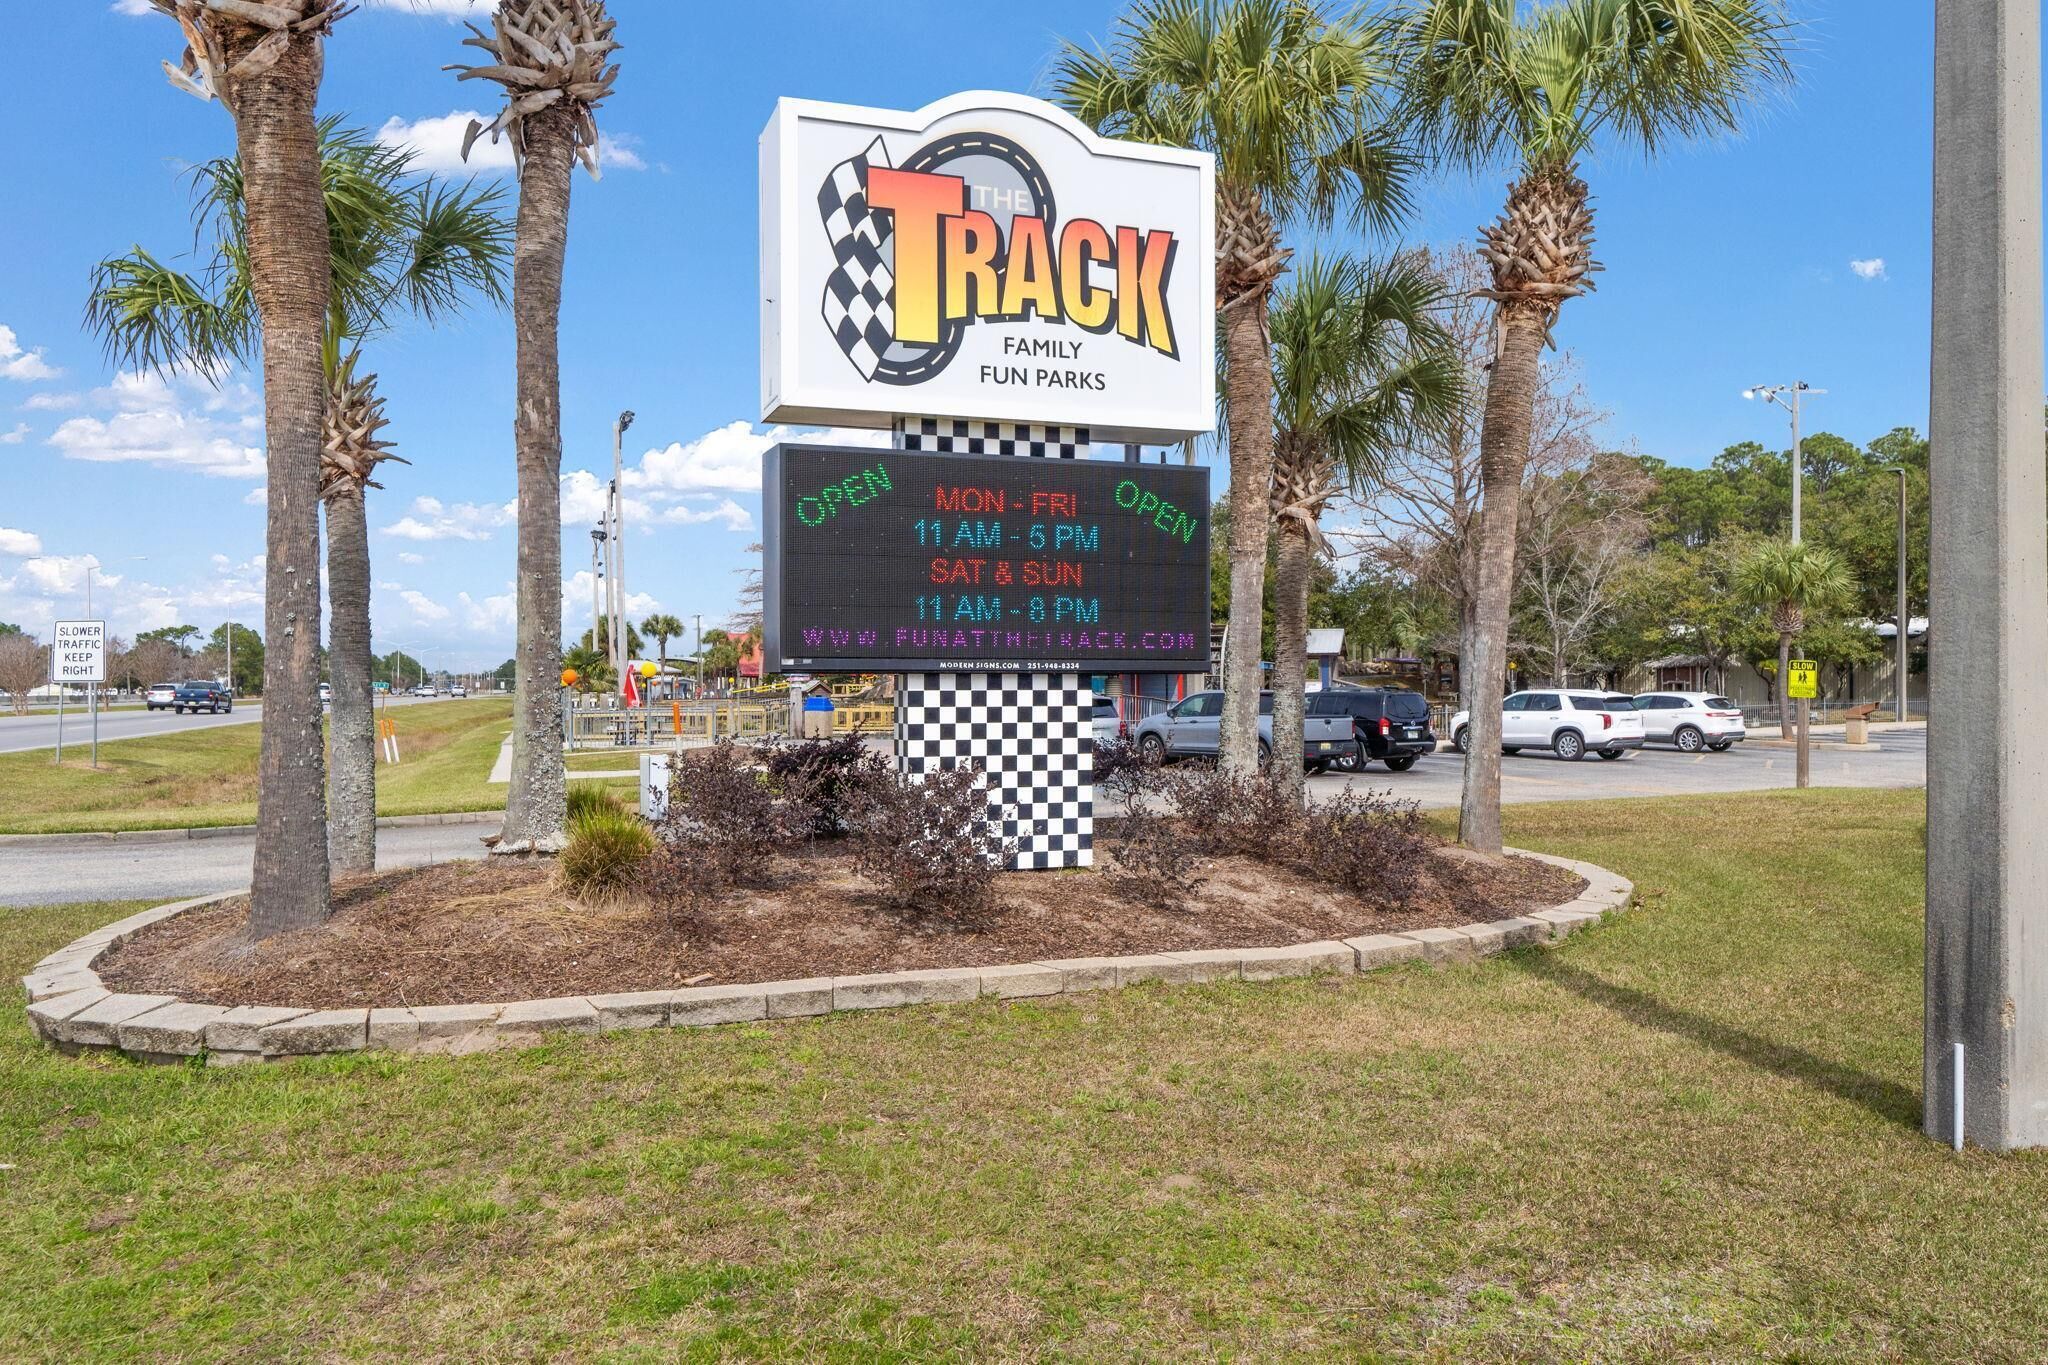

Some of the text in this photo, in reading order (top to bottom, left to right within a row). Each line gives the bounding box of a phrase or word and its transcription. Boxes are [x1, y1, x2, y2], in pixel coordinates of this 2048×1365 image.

[973, 184, 1030, 212] THE
[866, 165, 1180, 361] TRACK
[1003, 336, 1083, 360] FAMILY
[980, 365, 1106, 392] FUN PARKS
[798, 463, 892, 526] OPEN
[935, 485, 1005, 513] MON
[1032, 491, 1077, 518] FRI
[1114, 479, 1198, 544] OPEN
[914, 519, 942, 546] 11
[951, 520, 1001, 548] AM
[1055, 523, 1099, 551] PM
[929, 557, 1083, 587] SAT & SUN
[915, 594, 942, 621] 11
[953, 594, 1001, 622] AM
[1029, 596, 1045, 623] 8
[1055, 596, 1099, 624] PM
[57, 639, 101, 649] TRAFFIC
[59, 626, 101, 636] SLOWER
[62, 665, 94, 675] RIGHT
[64, 652, 93, 662] KEEP
[939, 661, 974, 670] MODERN
[1027, 662, 1080, 670] 251-948-8334
[1792, 662, 1814, 670] SLOW
